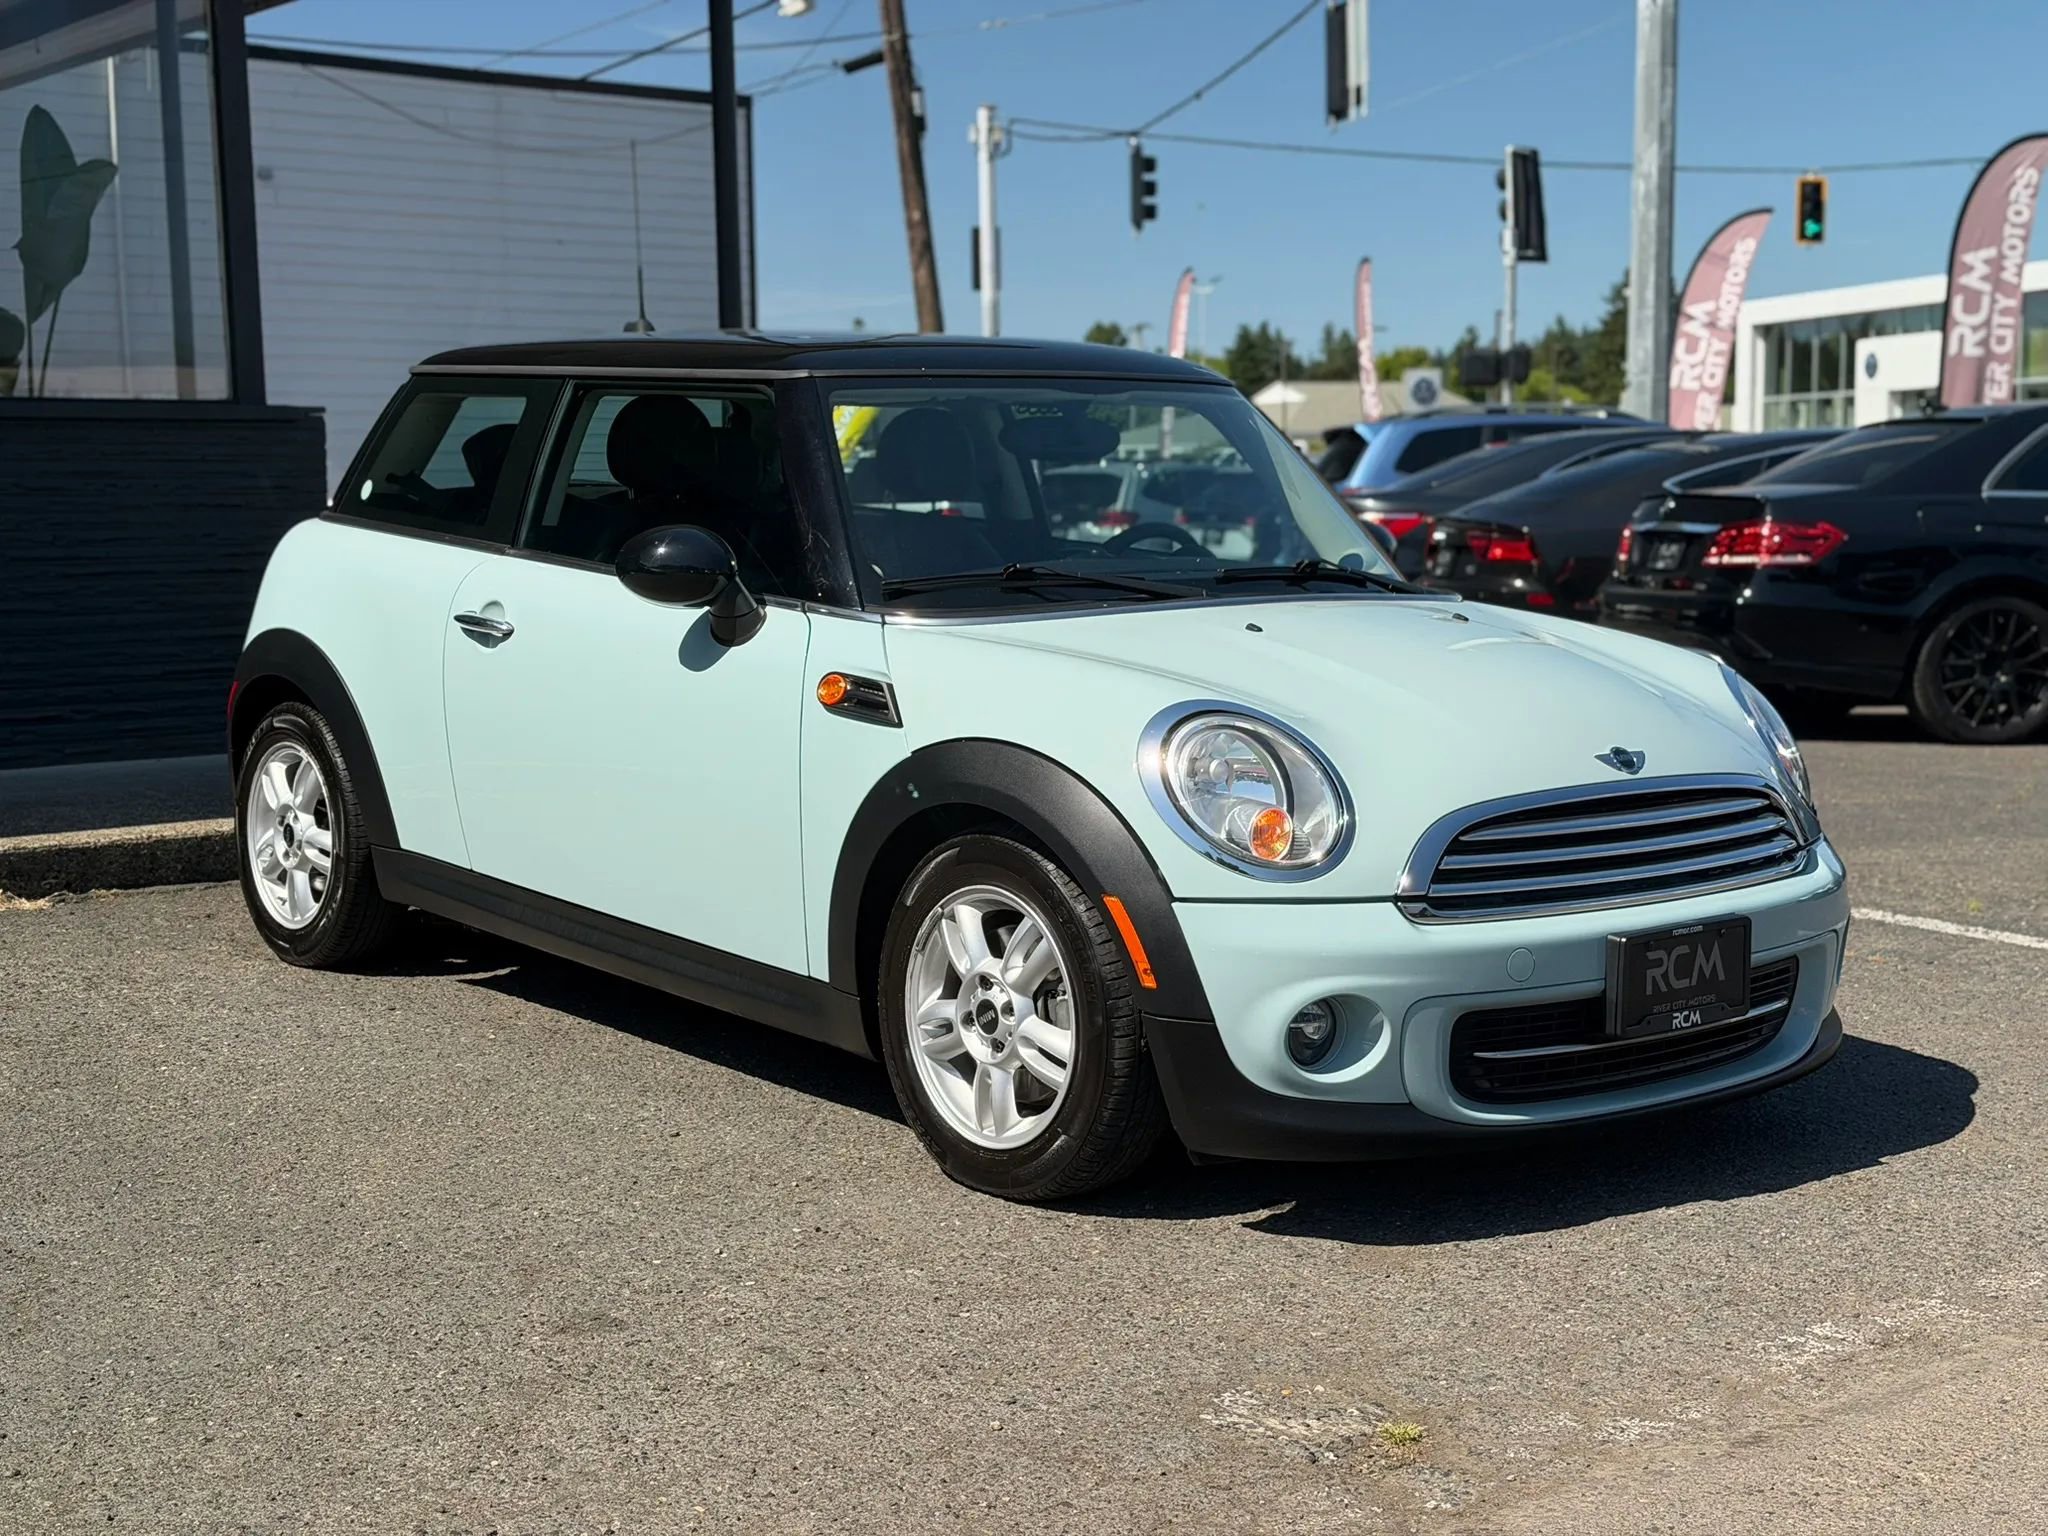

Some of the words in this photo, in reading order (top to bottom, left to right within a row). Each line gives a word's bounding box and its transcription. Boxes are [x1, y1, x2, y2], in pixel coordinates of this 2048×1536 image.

[2000, 166, 2040, 285] MOTORS
[1670, 302, 1716, 390] RCM
[1701, 337, 1729, 388] CITY
[1716, 236, 1757, 331] MOTORS
[1949, 246, 1997, 358] RCM
[1989, 294, 2017, 354] CITY
[1646, 940, 1725, 995] RCM
[1672, 1010, 1702, 1029] RCM
